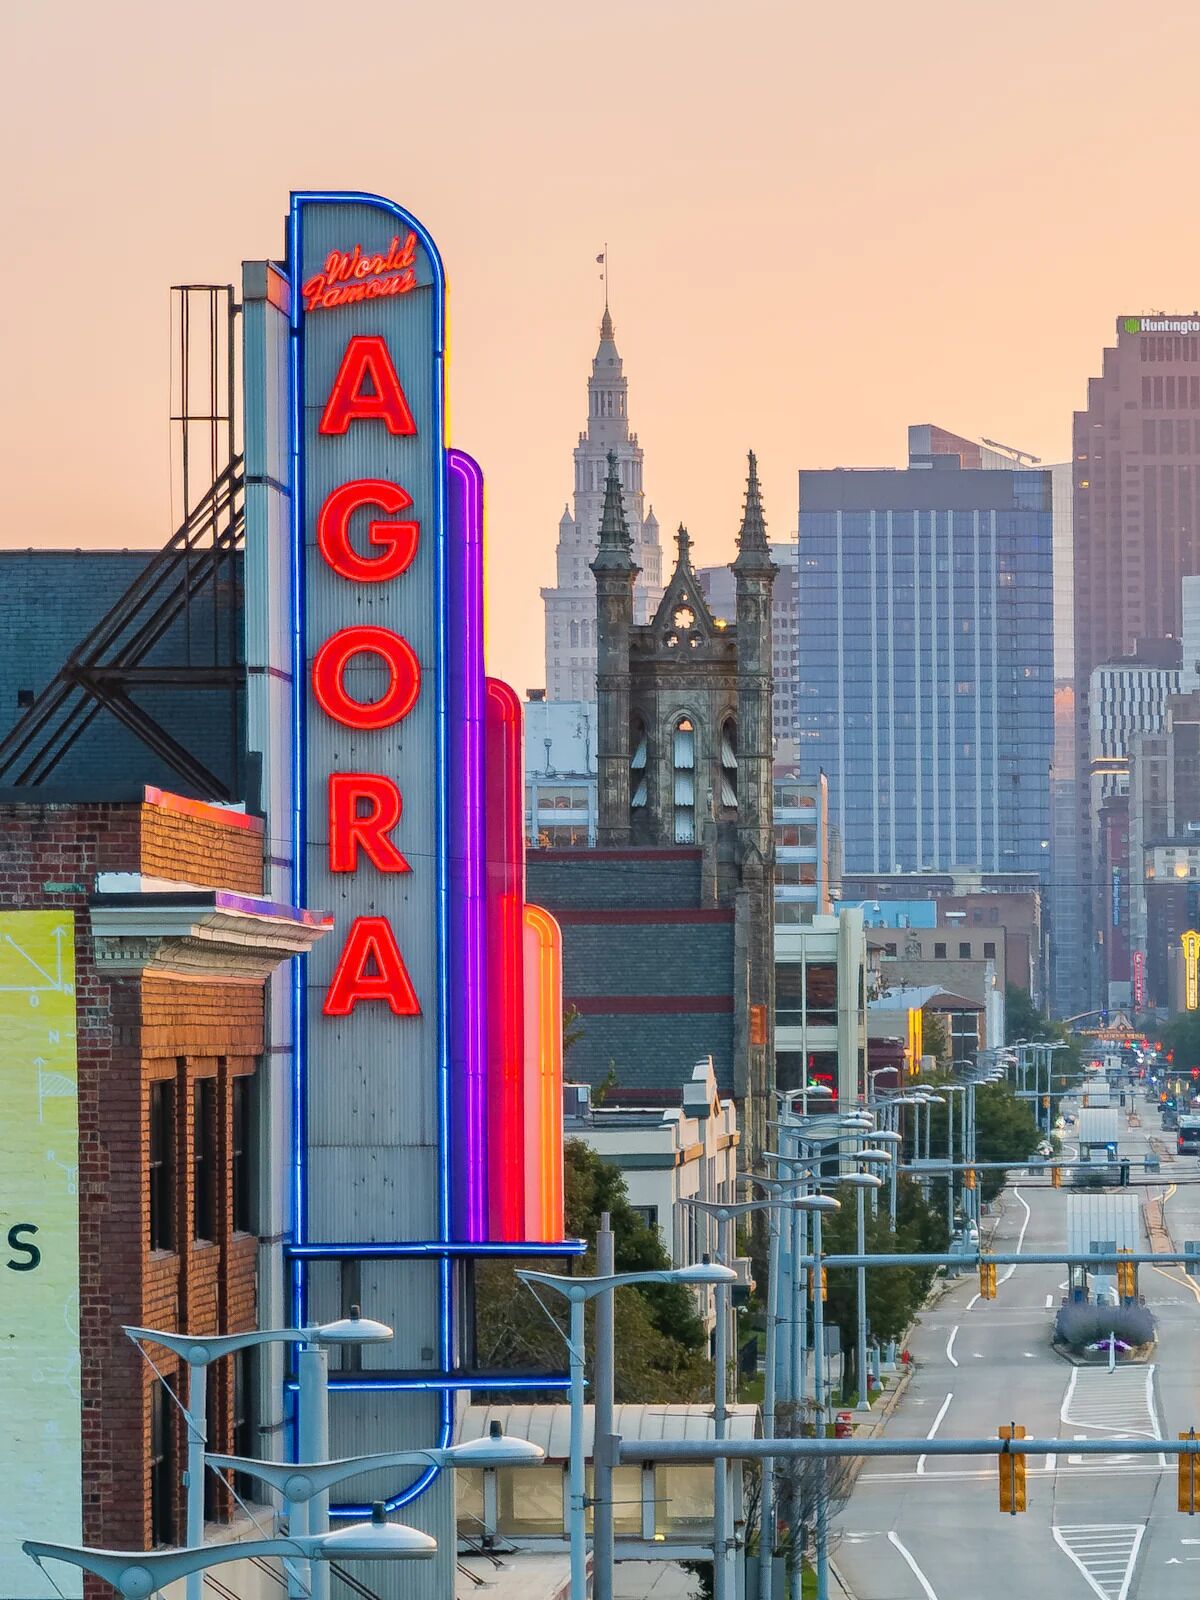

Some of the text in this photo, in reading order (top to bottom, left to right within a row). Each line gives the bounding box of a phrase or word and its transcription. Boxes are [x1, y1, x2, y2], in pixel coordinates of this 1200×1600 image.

[326, 231, 417, 285] World
[302, 268, 416, 311] Famous
[312, 335, 421, 1017] AGORA
[6, 1223, 41, 1271] S
